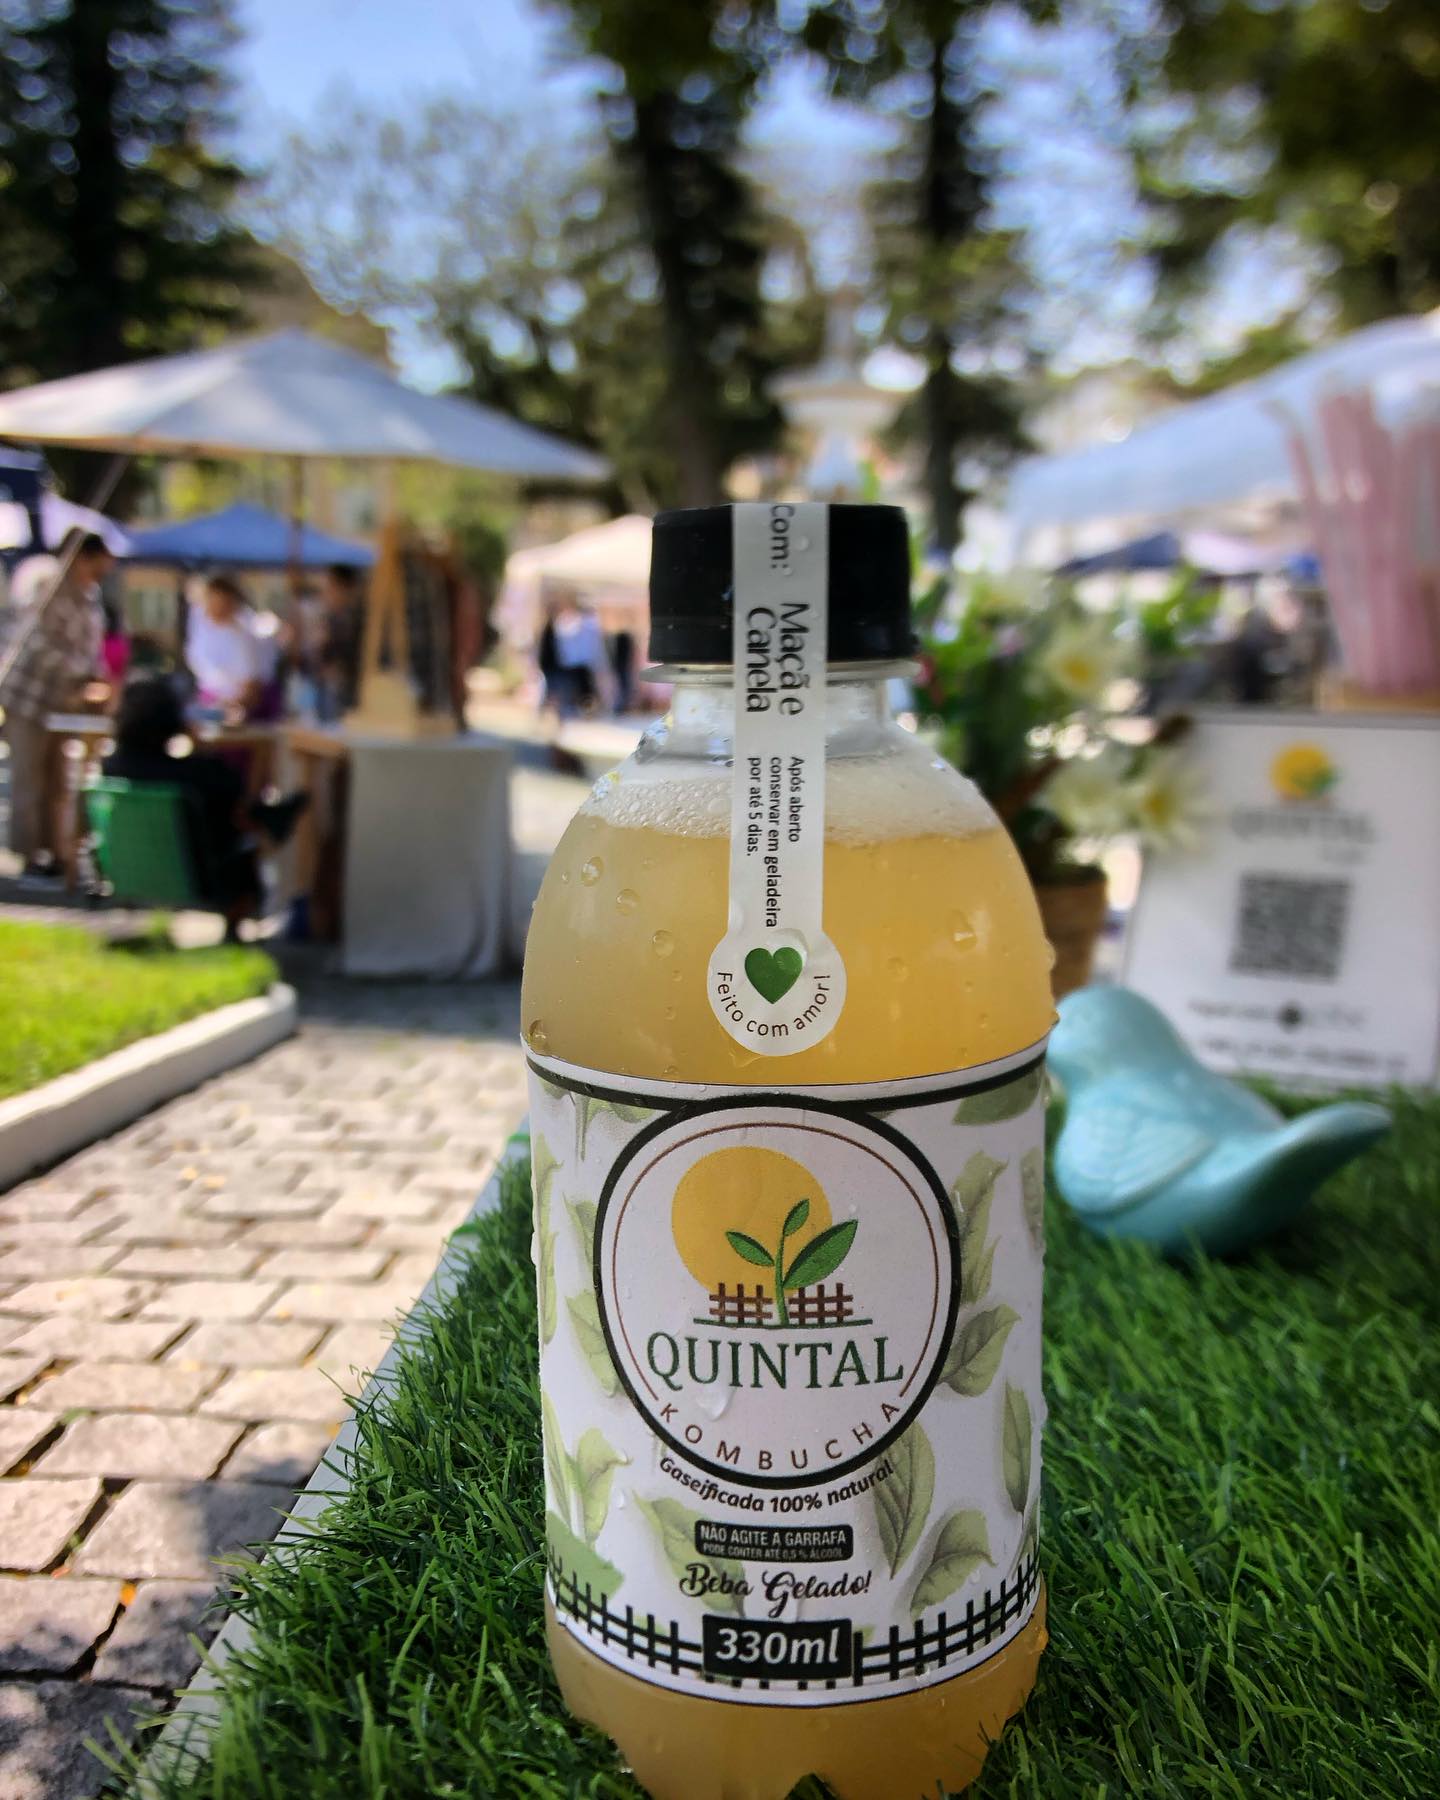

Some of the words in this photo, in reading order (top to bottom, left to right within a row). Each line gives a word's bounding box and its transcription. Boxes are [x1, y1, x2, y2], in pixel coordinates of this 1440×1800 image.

[771, 505, 795, 569] Com:
[746, 607, 778, 713] Canela
[775, 603, 810, 690] Maçã
[779, 697, 804, 715] e
[747, 757, 762, 782] por
[768, 757, 782, 825] conservar
[787, 757, 805, 792] Após
[748, 812, 762, 820] 5
[749, 787, 764, 808] até
[787, 797, 804, 842] aberto
[747, 824, 763, 857] dias.
[767, 829, 780, 852] em
[764, 856, 782, 928] geladeira
[717, 971, 744, 1022] Feito
[746, 1019, 789, 1037] com
[793, 975, 831, 1031] amor!
[647, 1331, 904, 1391] QUINTAL
[660, 1402, 900, 1470] KOMBUCHA
[659, 1457, 764, 1512] Gaseificada
[770, 1494, 823, 1513] 100%
[827, 1459, 894, 1506] natural
[700, 1524, 727, 1542] NÃO
[731, 1529, 769, 1545] AGITE
[772, 1532, 782, 1546] A
[785, 1530, 846, 1546] GARRAFA
[703, 1543, 725, 1554] PODE
[728, 1546, 762, 1558] CONTER
[764, 1546, 781, 1559] ATÉ
[679, 1562, 753, 1597] Beba
[762, 1570, 872, 1618] Gelado!
[715, 1627, 840, 1664] 330ml
